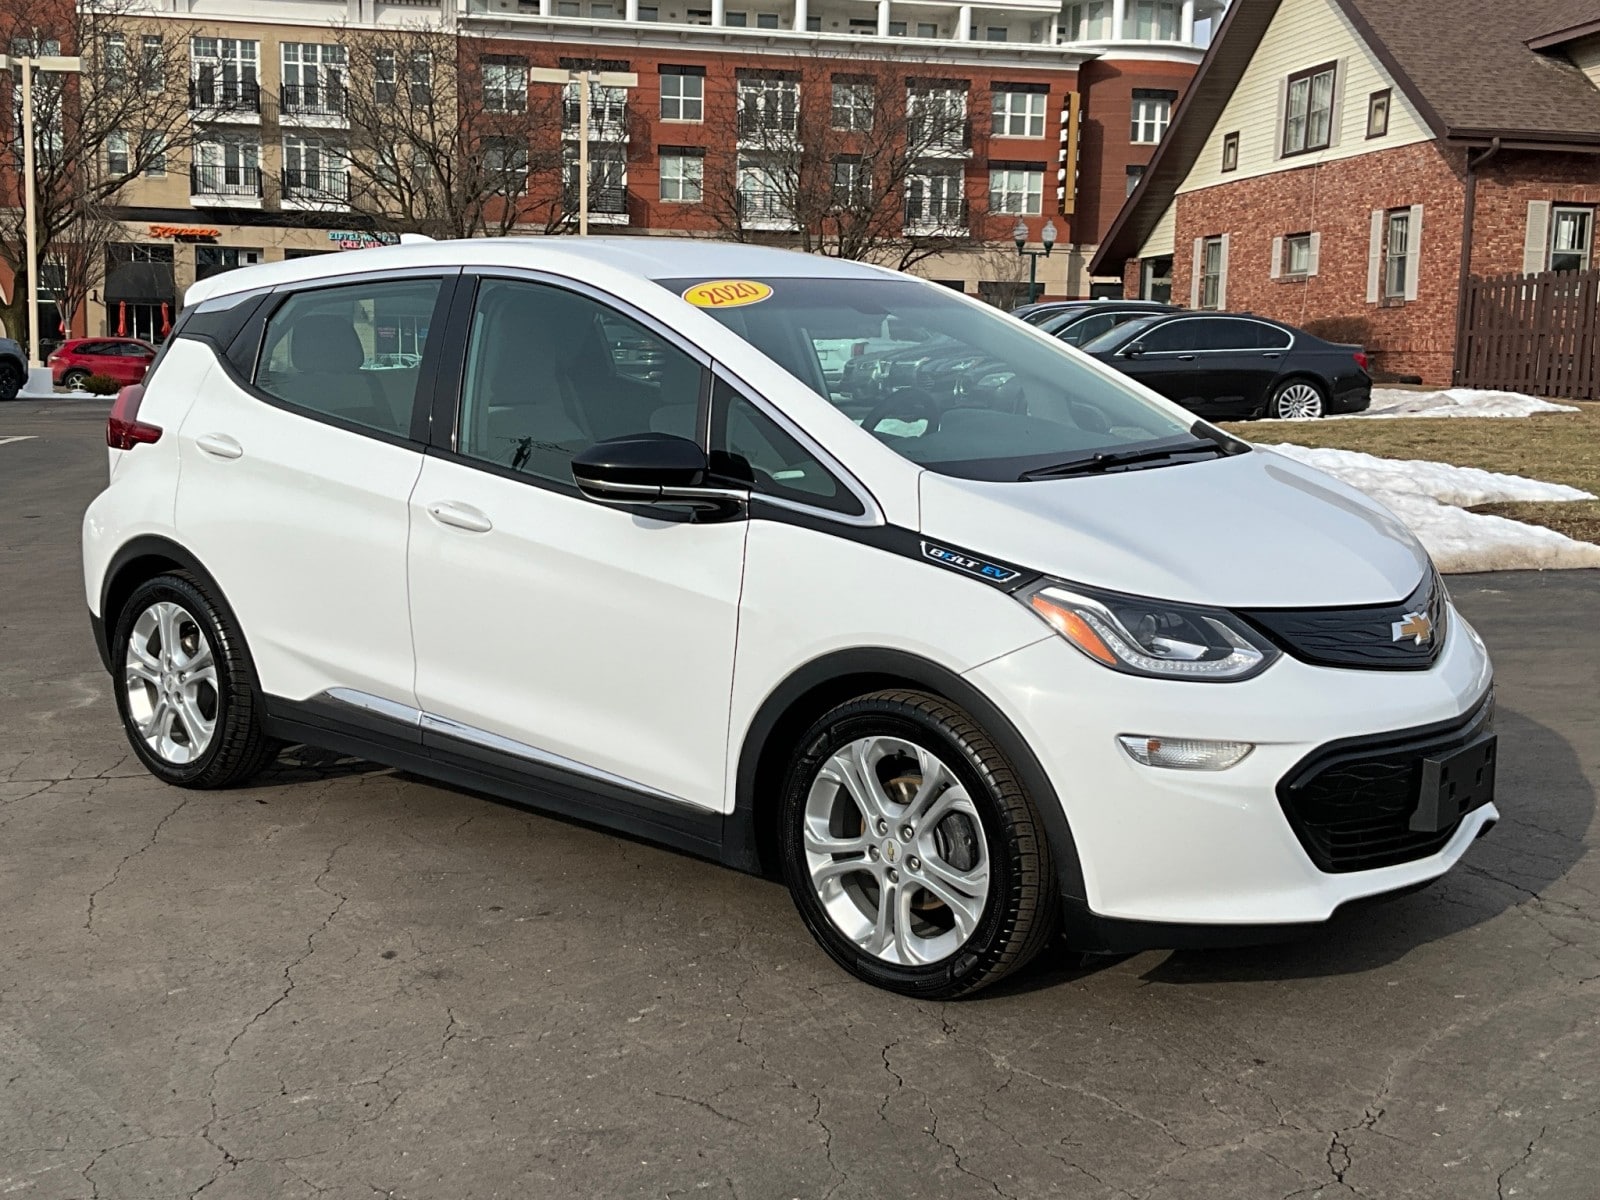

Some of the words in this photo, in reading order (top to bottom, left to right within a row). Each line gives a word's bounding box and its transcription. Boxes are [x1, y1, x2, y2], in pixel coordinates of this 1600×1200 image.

[698, 282, 759, 305] 2020
[929, 547, 980, 568] BOLT
[981, 565, 1009, 578] EV
